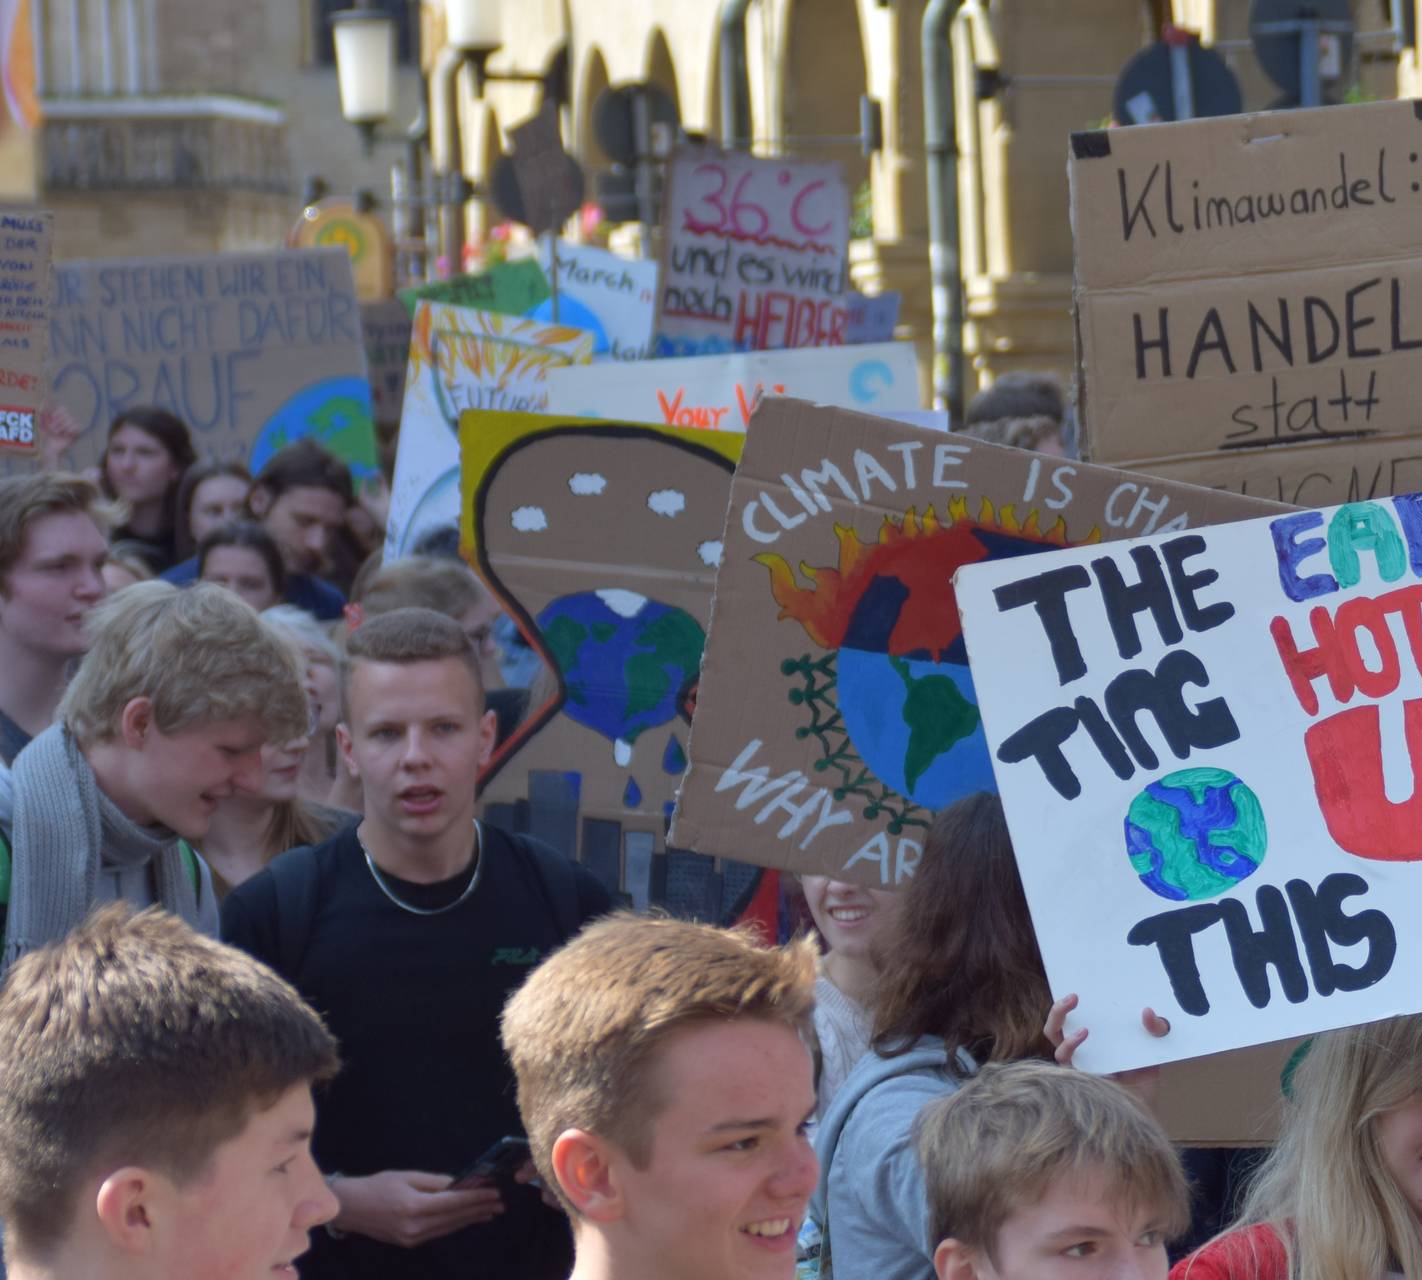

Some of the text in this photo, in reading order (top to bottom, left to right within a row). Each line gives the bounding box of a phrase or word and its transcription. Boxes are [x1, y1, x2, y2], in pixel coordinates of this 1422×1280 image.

[683, 162, 834, 240] 36°C
[1118, 148, 1421, 241] Klimawandel:
[99, 262, 204, 306] STEHEN
[216, 260, 267, 297] WIR
[549, 254, 634, 293] March
[665, 284, 732, 319] noch
[671, 240, 846, 296] und es wird
[120, 302, 218, 352] NICHT
[656, 388, 729, 430] Your
[1226, 369, 1380, 440] statt
[742, 441, 971, 544] CLIMATE
[1022, 459, 1077, 510] IS
[992, 534, 1236, 687] THE
[715, 739, 853, 850] WHY
[1127, 872, 1397, 1017] THIS
